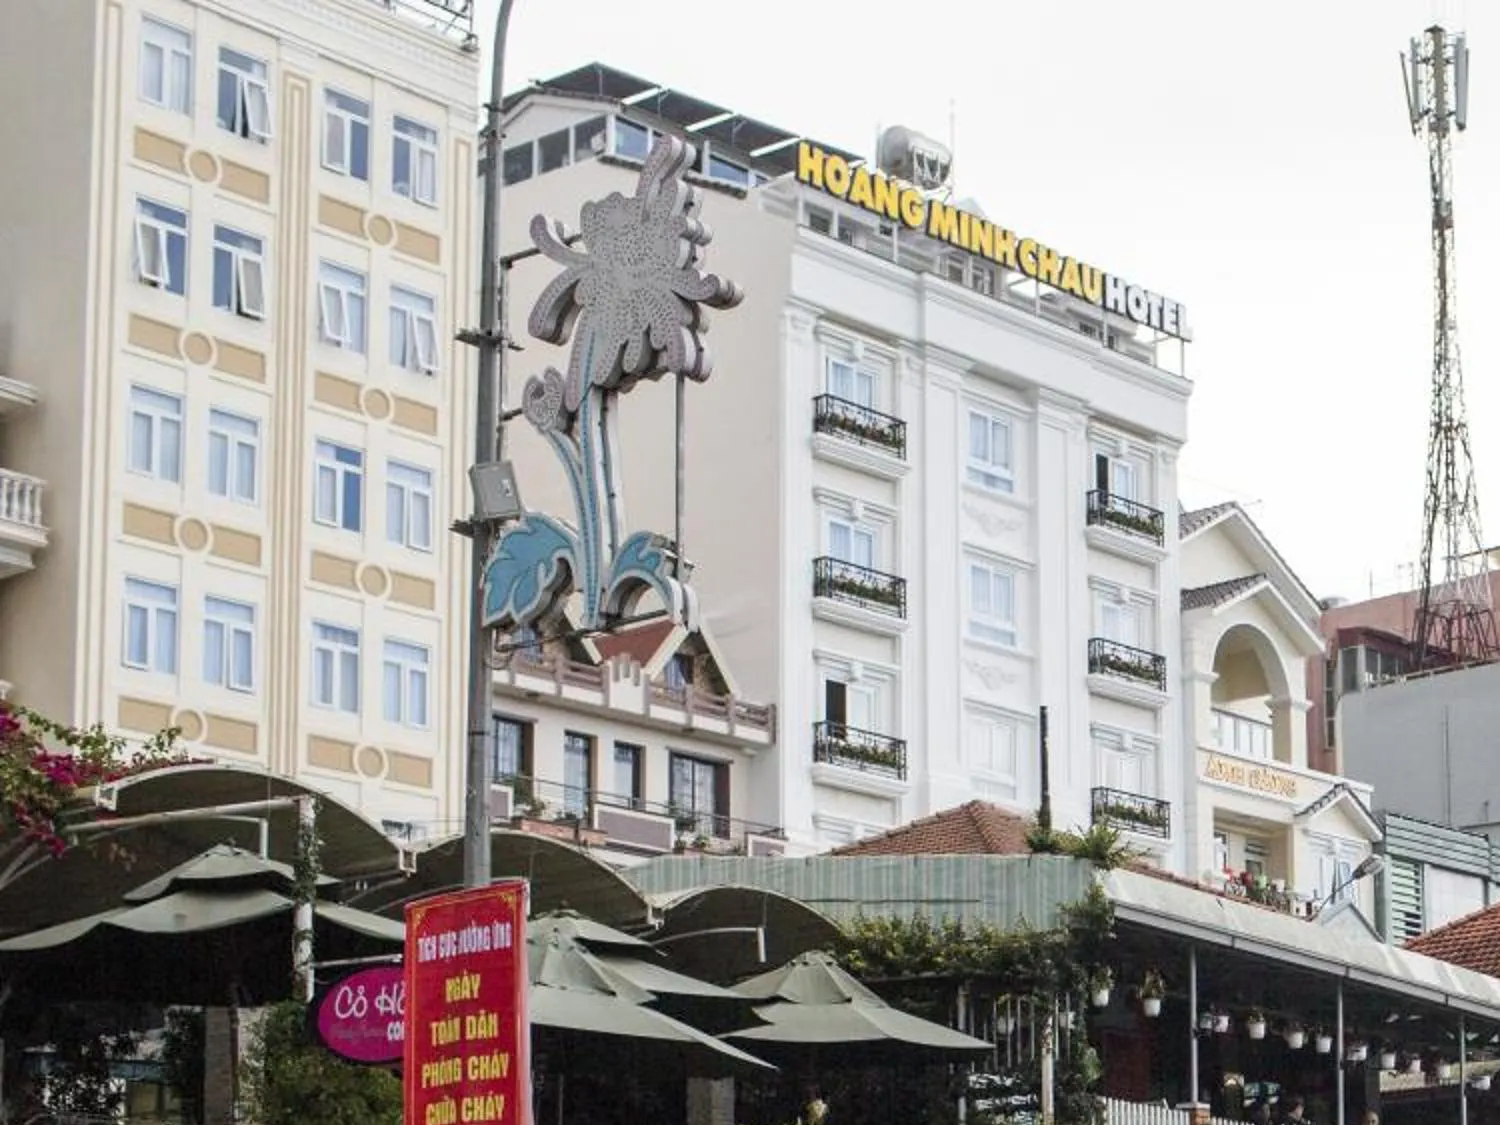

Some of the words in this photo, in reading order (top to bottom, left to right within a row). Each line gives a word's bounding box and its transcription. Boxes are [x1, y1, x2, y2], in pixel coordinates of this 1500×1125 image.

[928, 200, 1017, 270] MINH
[1017, 237, 1101, 305] CHAU
[1102, 272, 1191, 341] HOTEL
